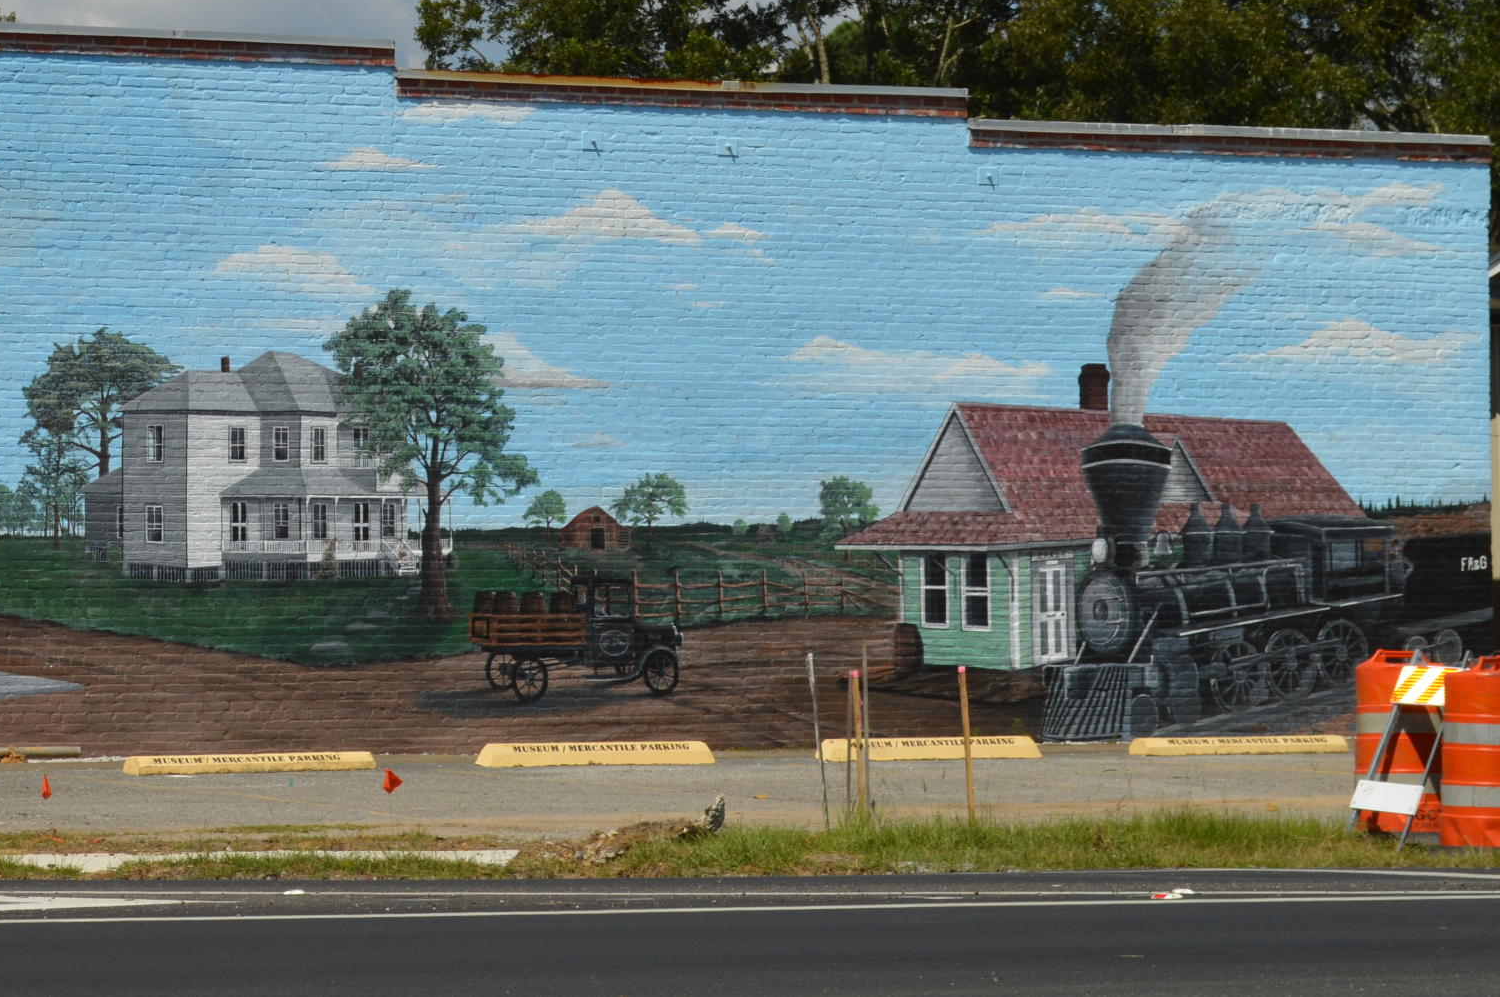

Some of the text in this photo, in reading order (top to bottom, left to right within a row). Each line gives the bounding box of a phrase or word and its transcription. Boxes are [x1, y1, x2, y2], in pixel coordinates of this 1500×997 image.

[1282, 736, 1328, 744] PARKING
[513, 745, 559, 753] MUSEUM
[569, 744, 637, 752] MERCANTILE
[641, 743, 690, 751] PARKING
[153, 757, 202, 765] MUSEUM
[289, 754, 341, 762] PARKING
